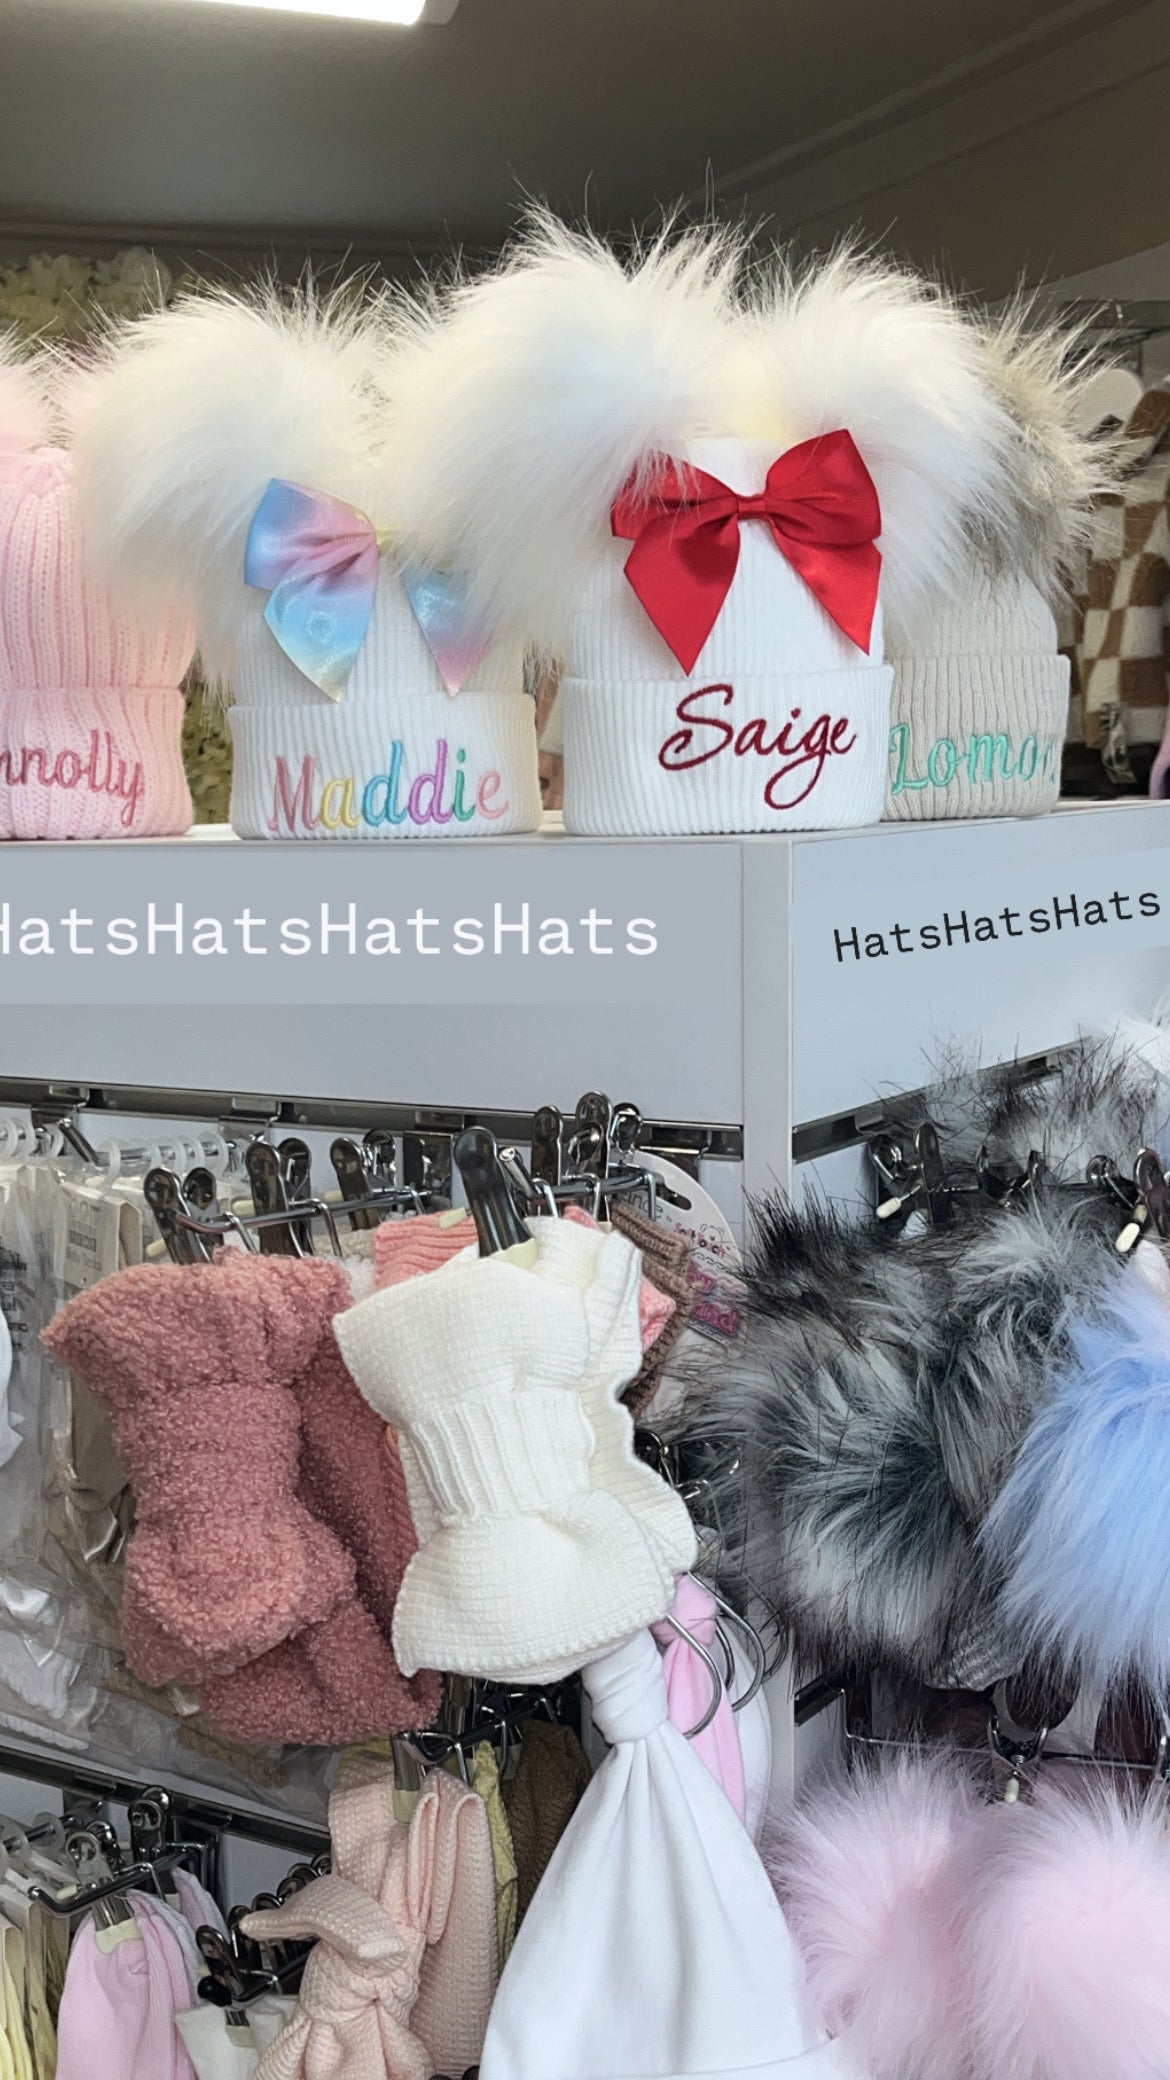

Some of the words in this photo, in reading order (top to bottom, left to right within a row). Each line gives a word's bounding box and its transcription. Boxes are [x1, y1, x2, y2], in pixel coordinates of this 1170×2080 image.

[267, 737, 510, 832] Maddie
[658, 683, 857, 810] Saige
[833, 891, 1161, 962] HatsHatsHats
